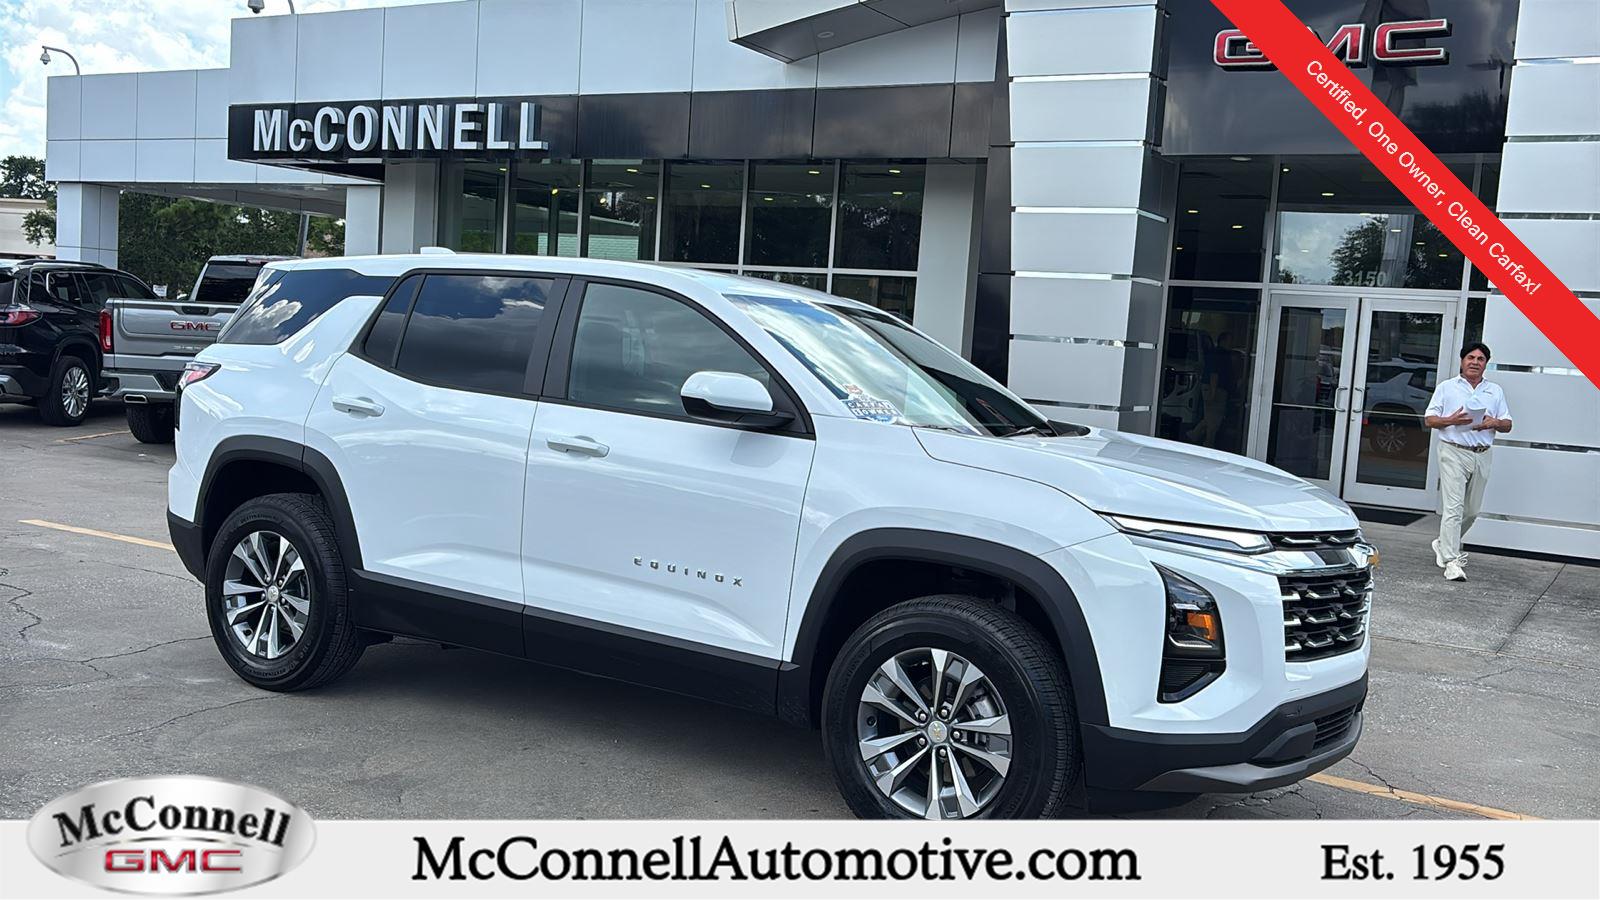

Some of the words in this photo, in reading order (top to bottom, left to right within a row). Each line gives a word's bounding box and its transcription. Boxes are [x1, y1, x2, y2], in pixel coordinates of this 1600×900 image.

[253, 101, 549, 152] McCONNELL
[1343, 269, 1387, 287] 3150
[170, 320, 221, 331] GMC
[633, 556, 743, 587] EQUINOX
